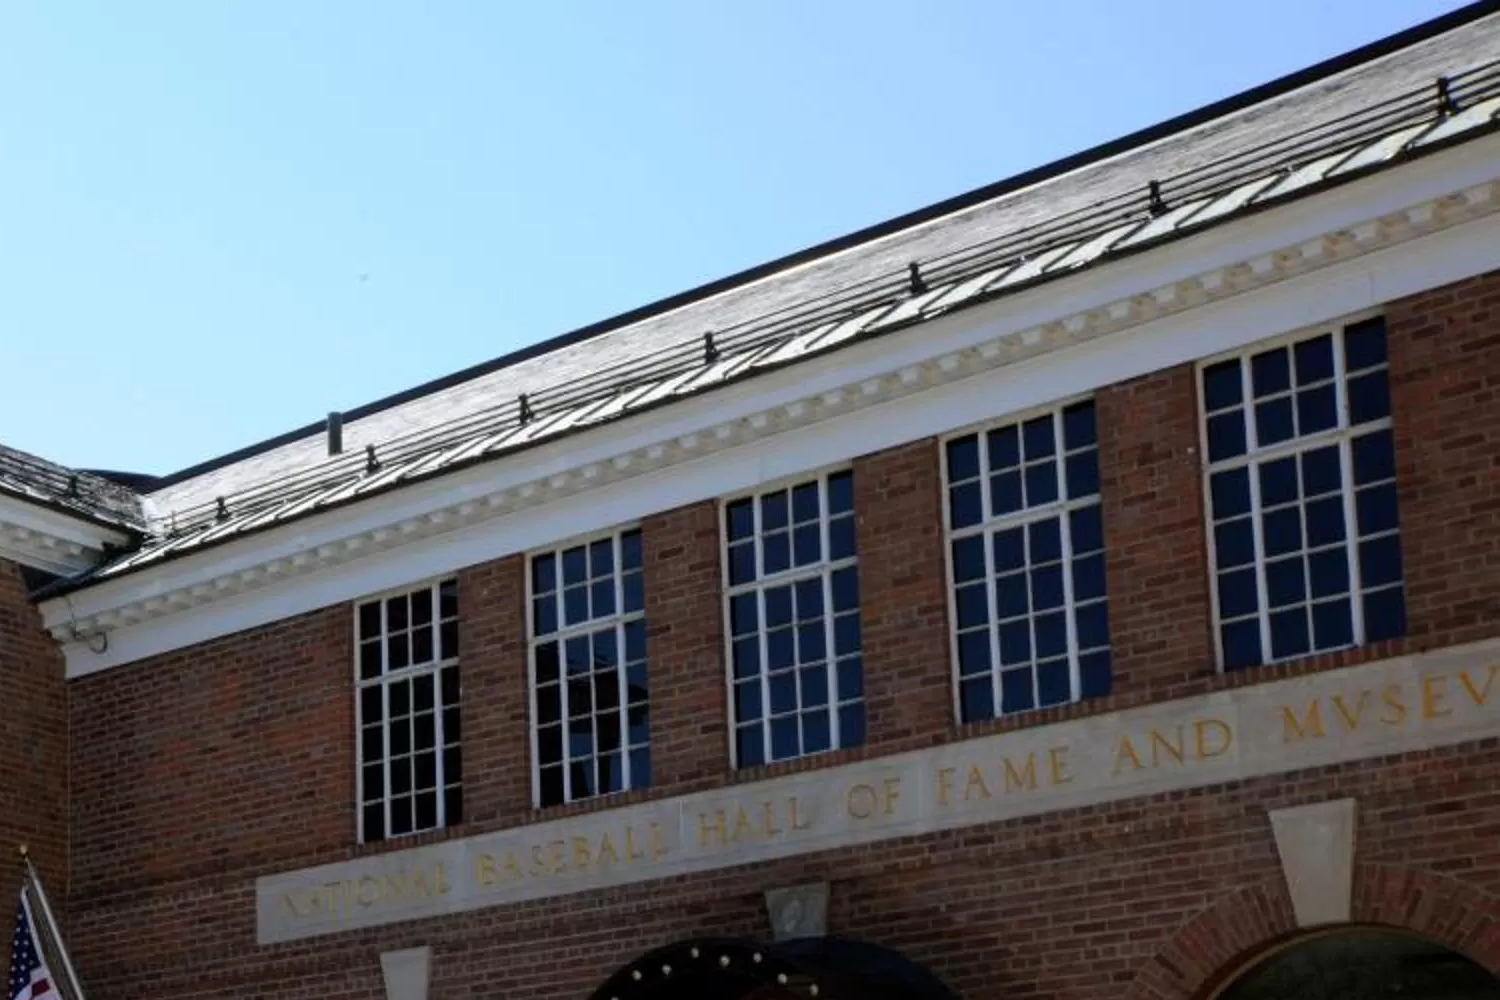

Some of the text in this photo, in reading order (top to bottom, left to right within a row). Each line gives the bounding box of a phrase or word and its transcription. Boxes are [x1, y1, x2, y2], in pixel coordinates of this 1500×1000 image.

[281, 862, 453, 919] NATIONAL
[474, 822, 671, 889] BASEBALL
[695, 796, 812, 847] HALL
[847, 774, 902, 821] OF
[935, 746, 1075, 807] FAME
[1110, 717, 1234, 777] AND
